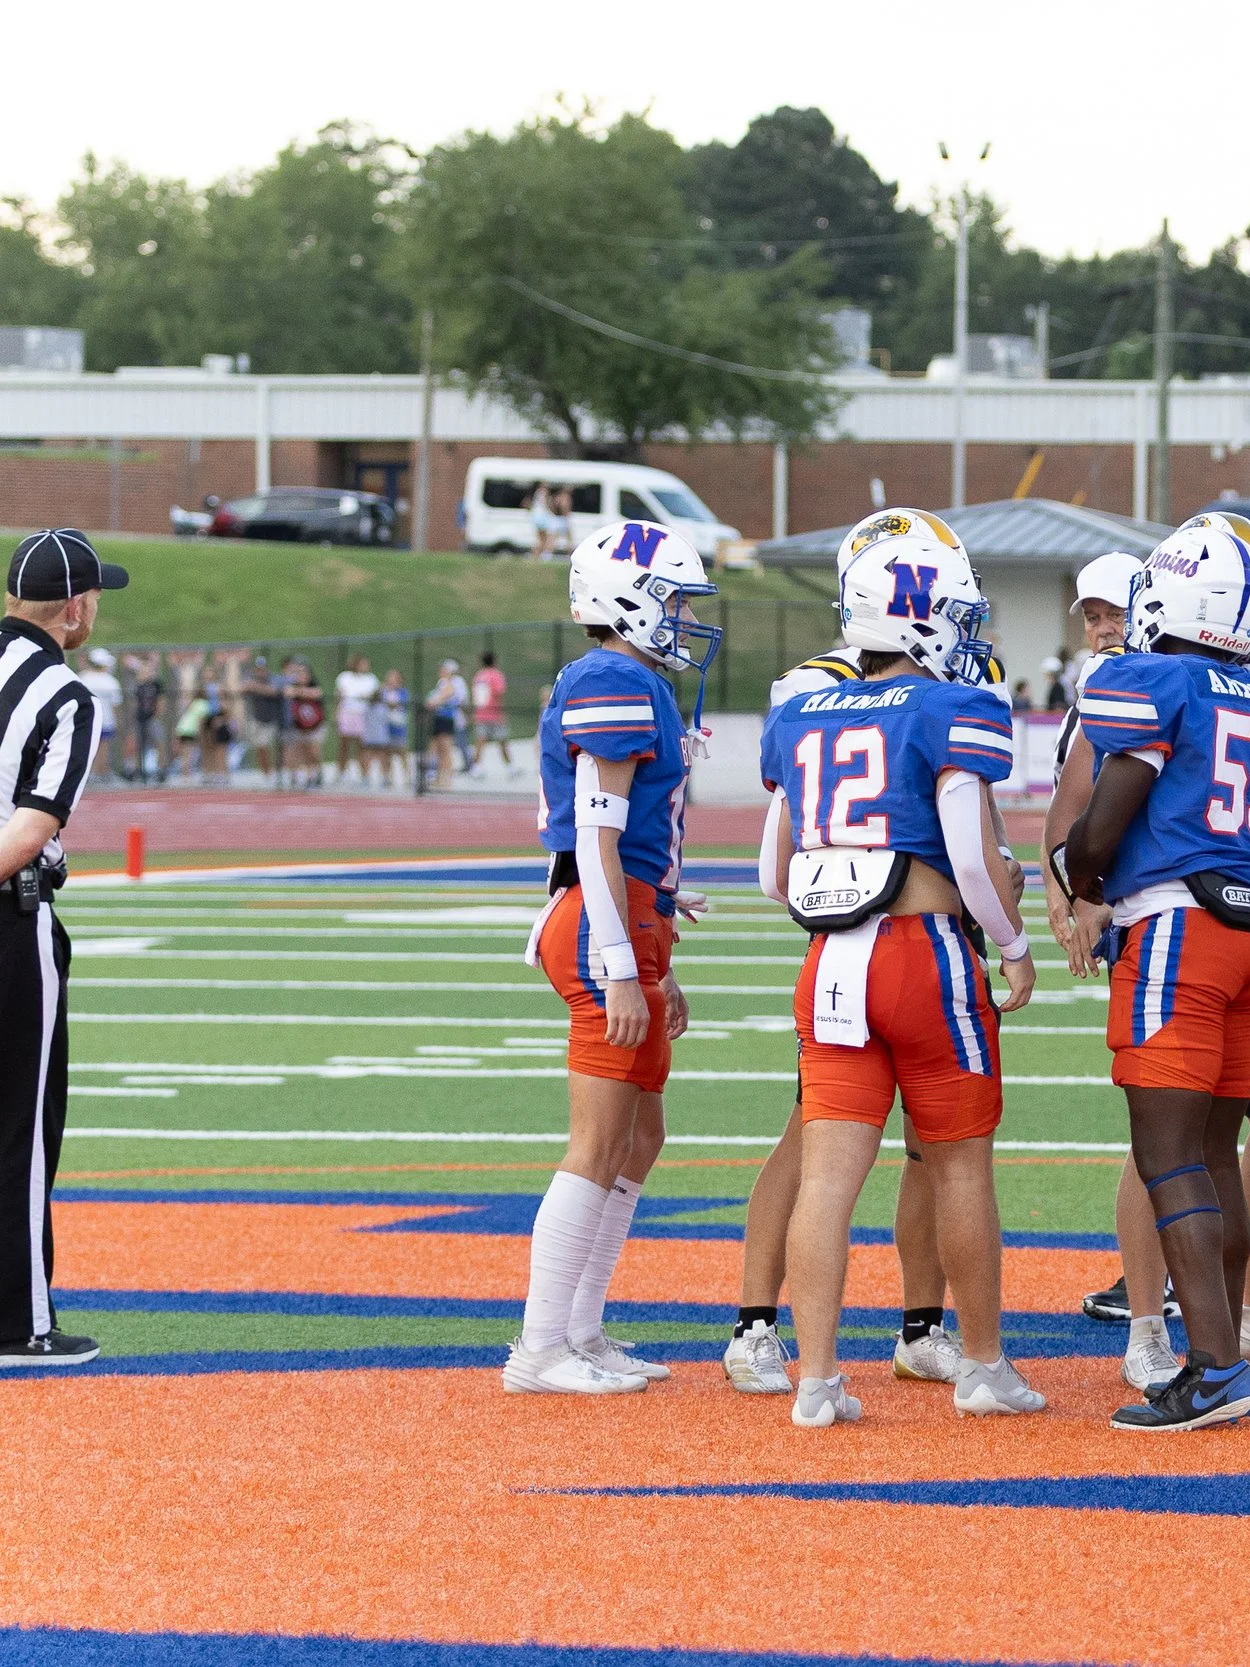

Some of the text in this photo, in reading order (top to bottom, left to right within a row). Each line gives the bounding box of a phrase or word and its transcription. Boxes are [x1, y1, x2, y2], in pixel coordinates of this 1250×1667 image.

[610, 523, 668, 569] N
[886, 563, 938, 621] N
[1199, 630, 1250, 651] Riddell
[800, 685, 915, 713] MANNING
[794, 724, 888, 849] 12
[806, 892, 854, 907] BATTLE
